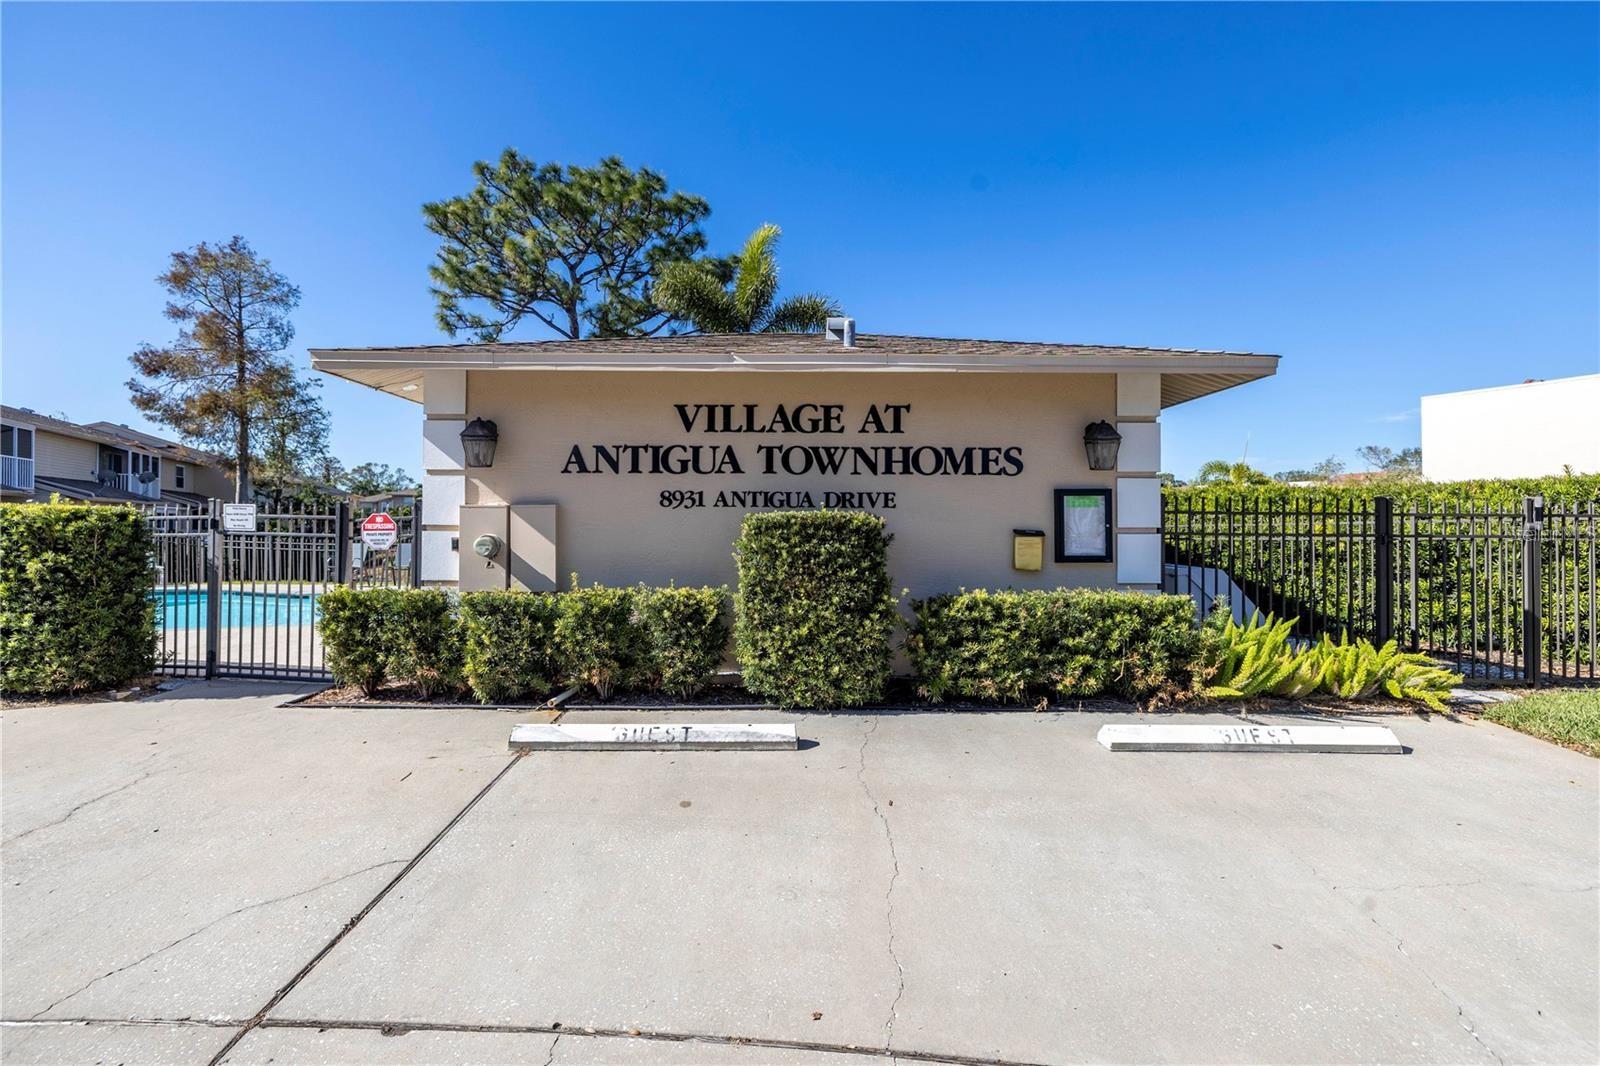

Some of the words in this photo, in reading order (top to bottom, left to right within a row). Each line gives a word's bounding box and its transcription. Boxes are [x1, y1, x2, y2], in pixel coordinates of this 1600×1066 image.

[673, 403, 845, 434] VILLAGE
[858, 403, 911, 434] AT
[560, 444, 745, 475] ANTIGUA
[757, 445, 1024, 477] TOWNHOMES
[659, 489, 705, 509] 8931
[713, 490, 811, 509] ANTIGUA
[823, 491, 896, 509] DRIVE
